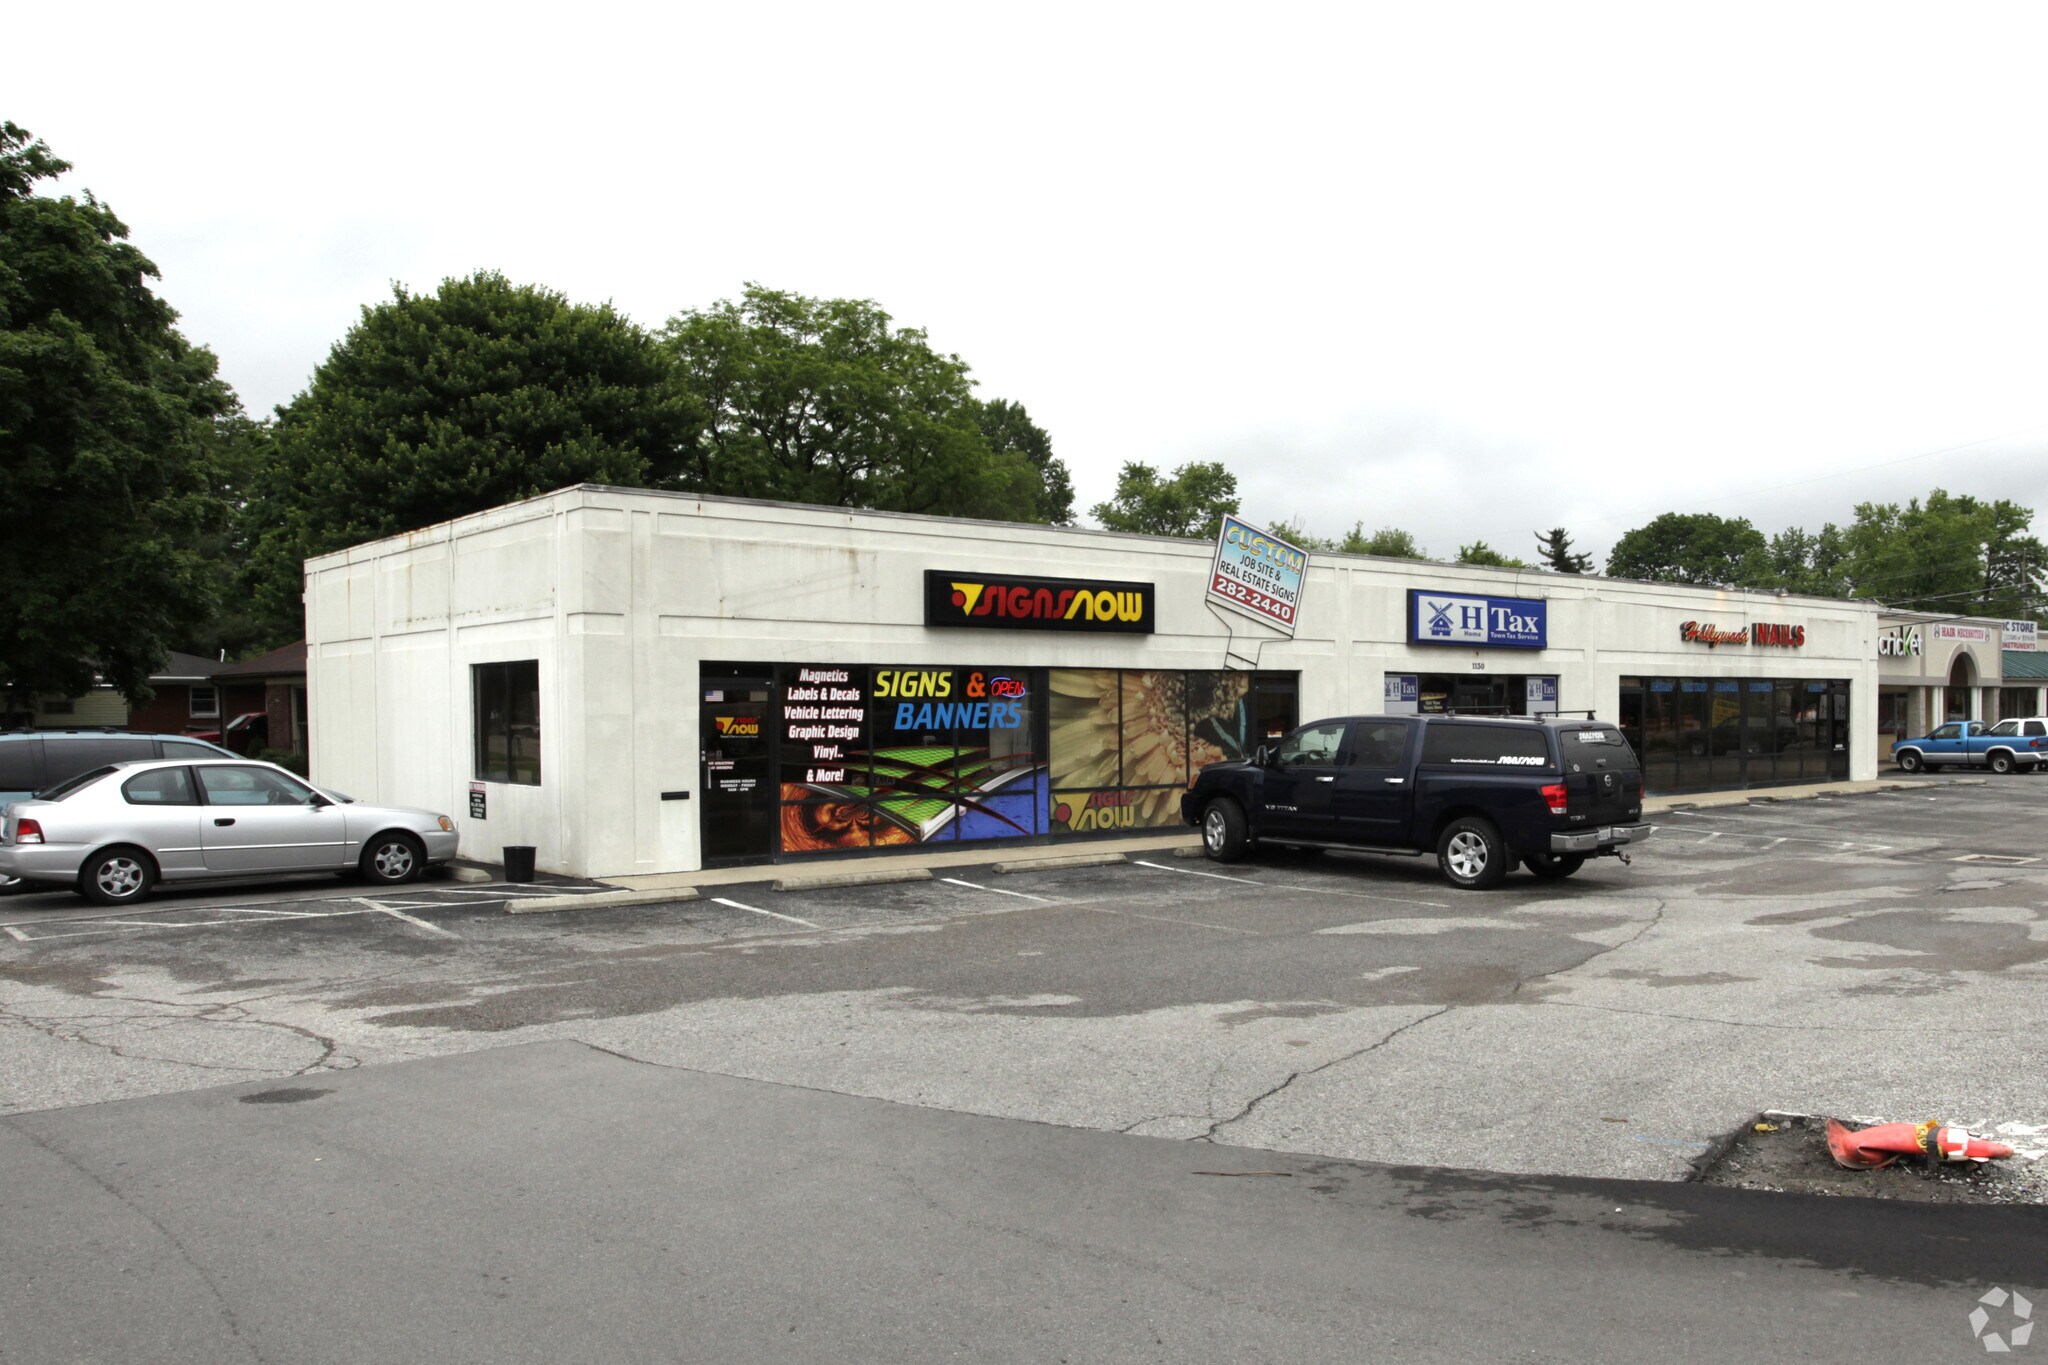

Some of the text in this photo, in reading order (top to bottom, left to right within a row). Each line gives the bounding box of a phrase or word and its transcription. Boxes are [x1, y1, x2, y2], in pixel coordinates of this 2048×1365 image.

[1226, 526, 1303, 575] CUSTOM
[1240, 555, 1281, 581] JOB SITE &
[1220, 560, 1295, 603] REAL ESTATE SIGNS
[1216, 578, 1291, 619] 282-2440
[1460, 605, 1539, 634] H Tax
[1682, 621, 1804, 647] Hollywood NAILS
[1941, 627, 1984, 639] HAIR NECESSITIES
[2012, 622, 2034, 633] STORE
[1879, 625, 1922, 656] cricket
[2002, 642, 2035, 650] INSTRUMENTS
[799, 669, 848, 684] Magnetics
[874, 671, 986, 698] SIGNS &
[991, 681, 1024, 696] OPEN
[1402, 682, 1415, 693] Tax
[1543, 683, 1554, 694] Tax
[787, 687, 860, 701] Labels & Decals
[784, 706, 864, 721] Vehicle Lettering
[894, 703, 1022, 730] BANNERS
[789, 725, 859, 740] Graphic Design
[806, 769, 844, 782] & More!
